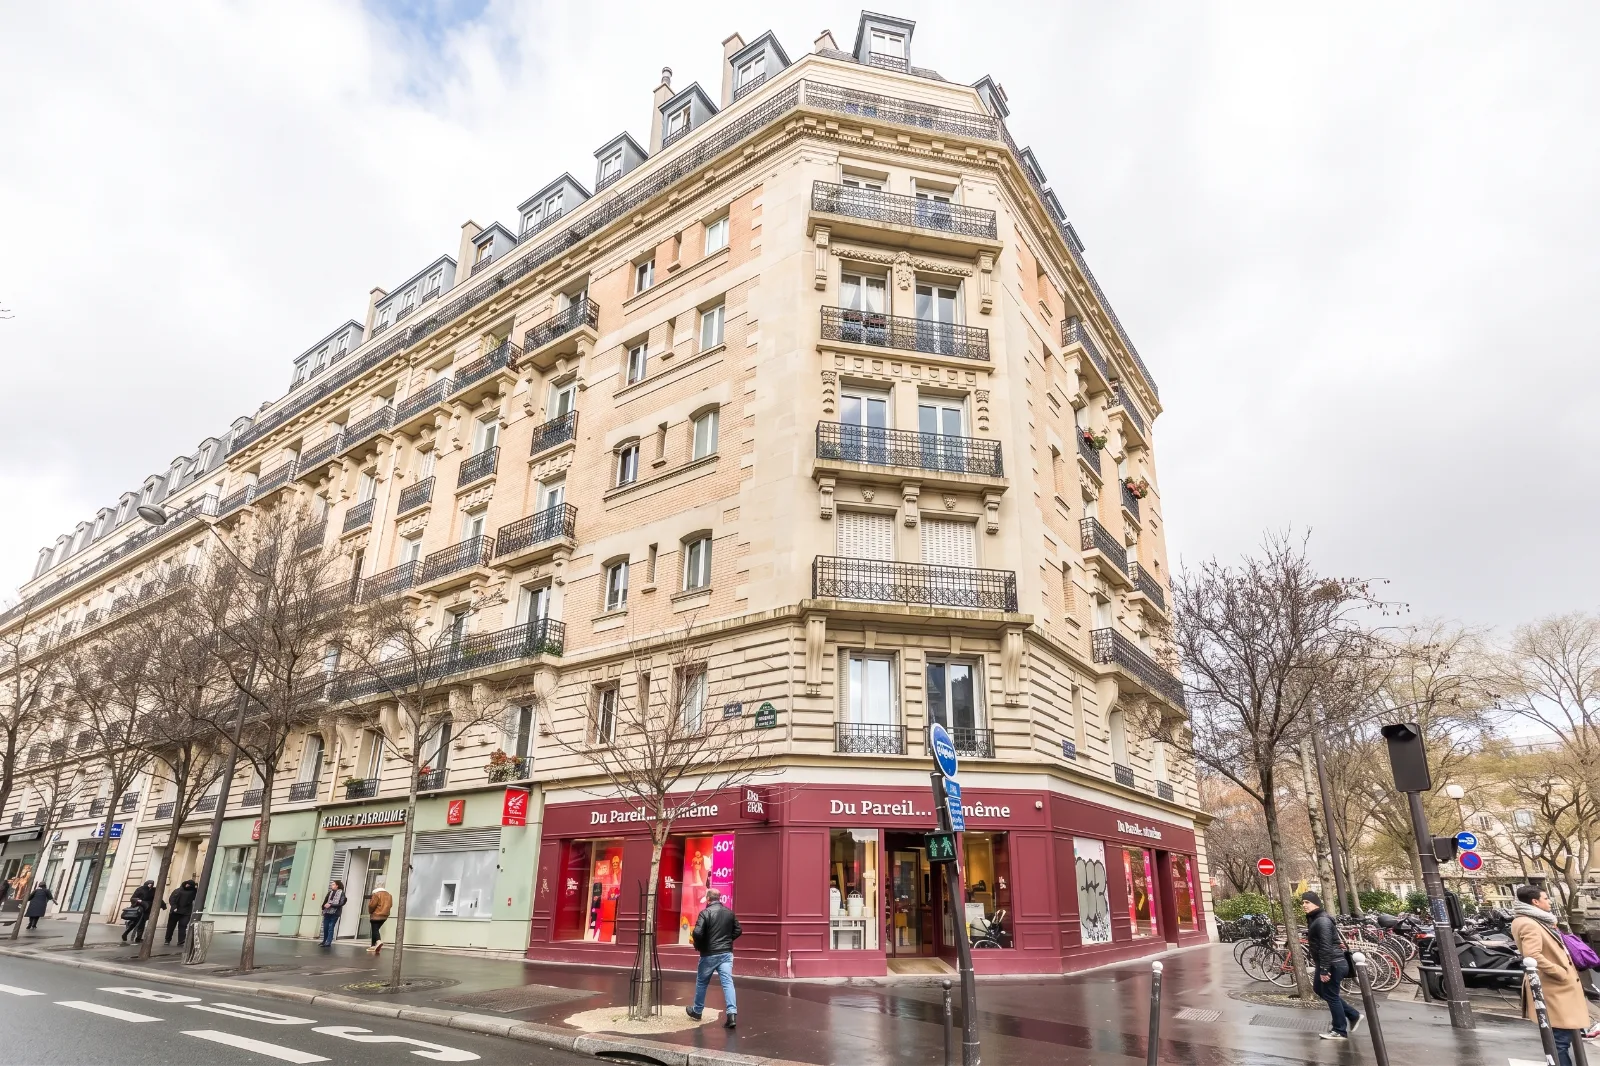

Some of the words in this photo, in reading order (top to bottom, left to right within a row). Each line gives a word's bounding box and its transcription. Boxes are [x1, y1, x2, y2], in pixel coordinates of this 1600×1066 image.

[590, 811, 608, 825] Du
[830, 799, 857, 815] Du
[861, 799, 932, 816] Pareil...
[962, 802, 1011, 818] même
[96, 986, 482, 1062] BUS
